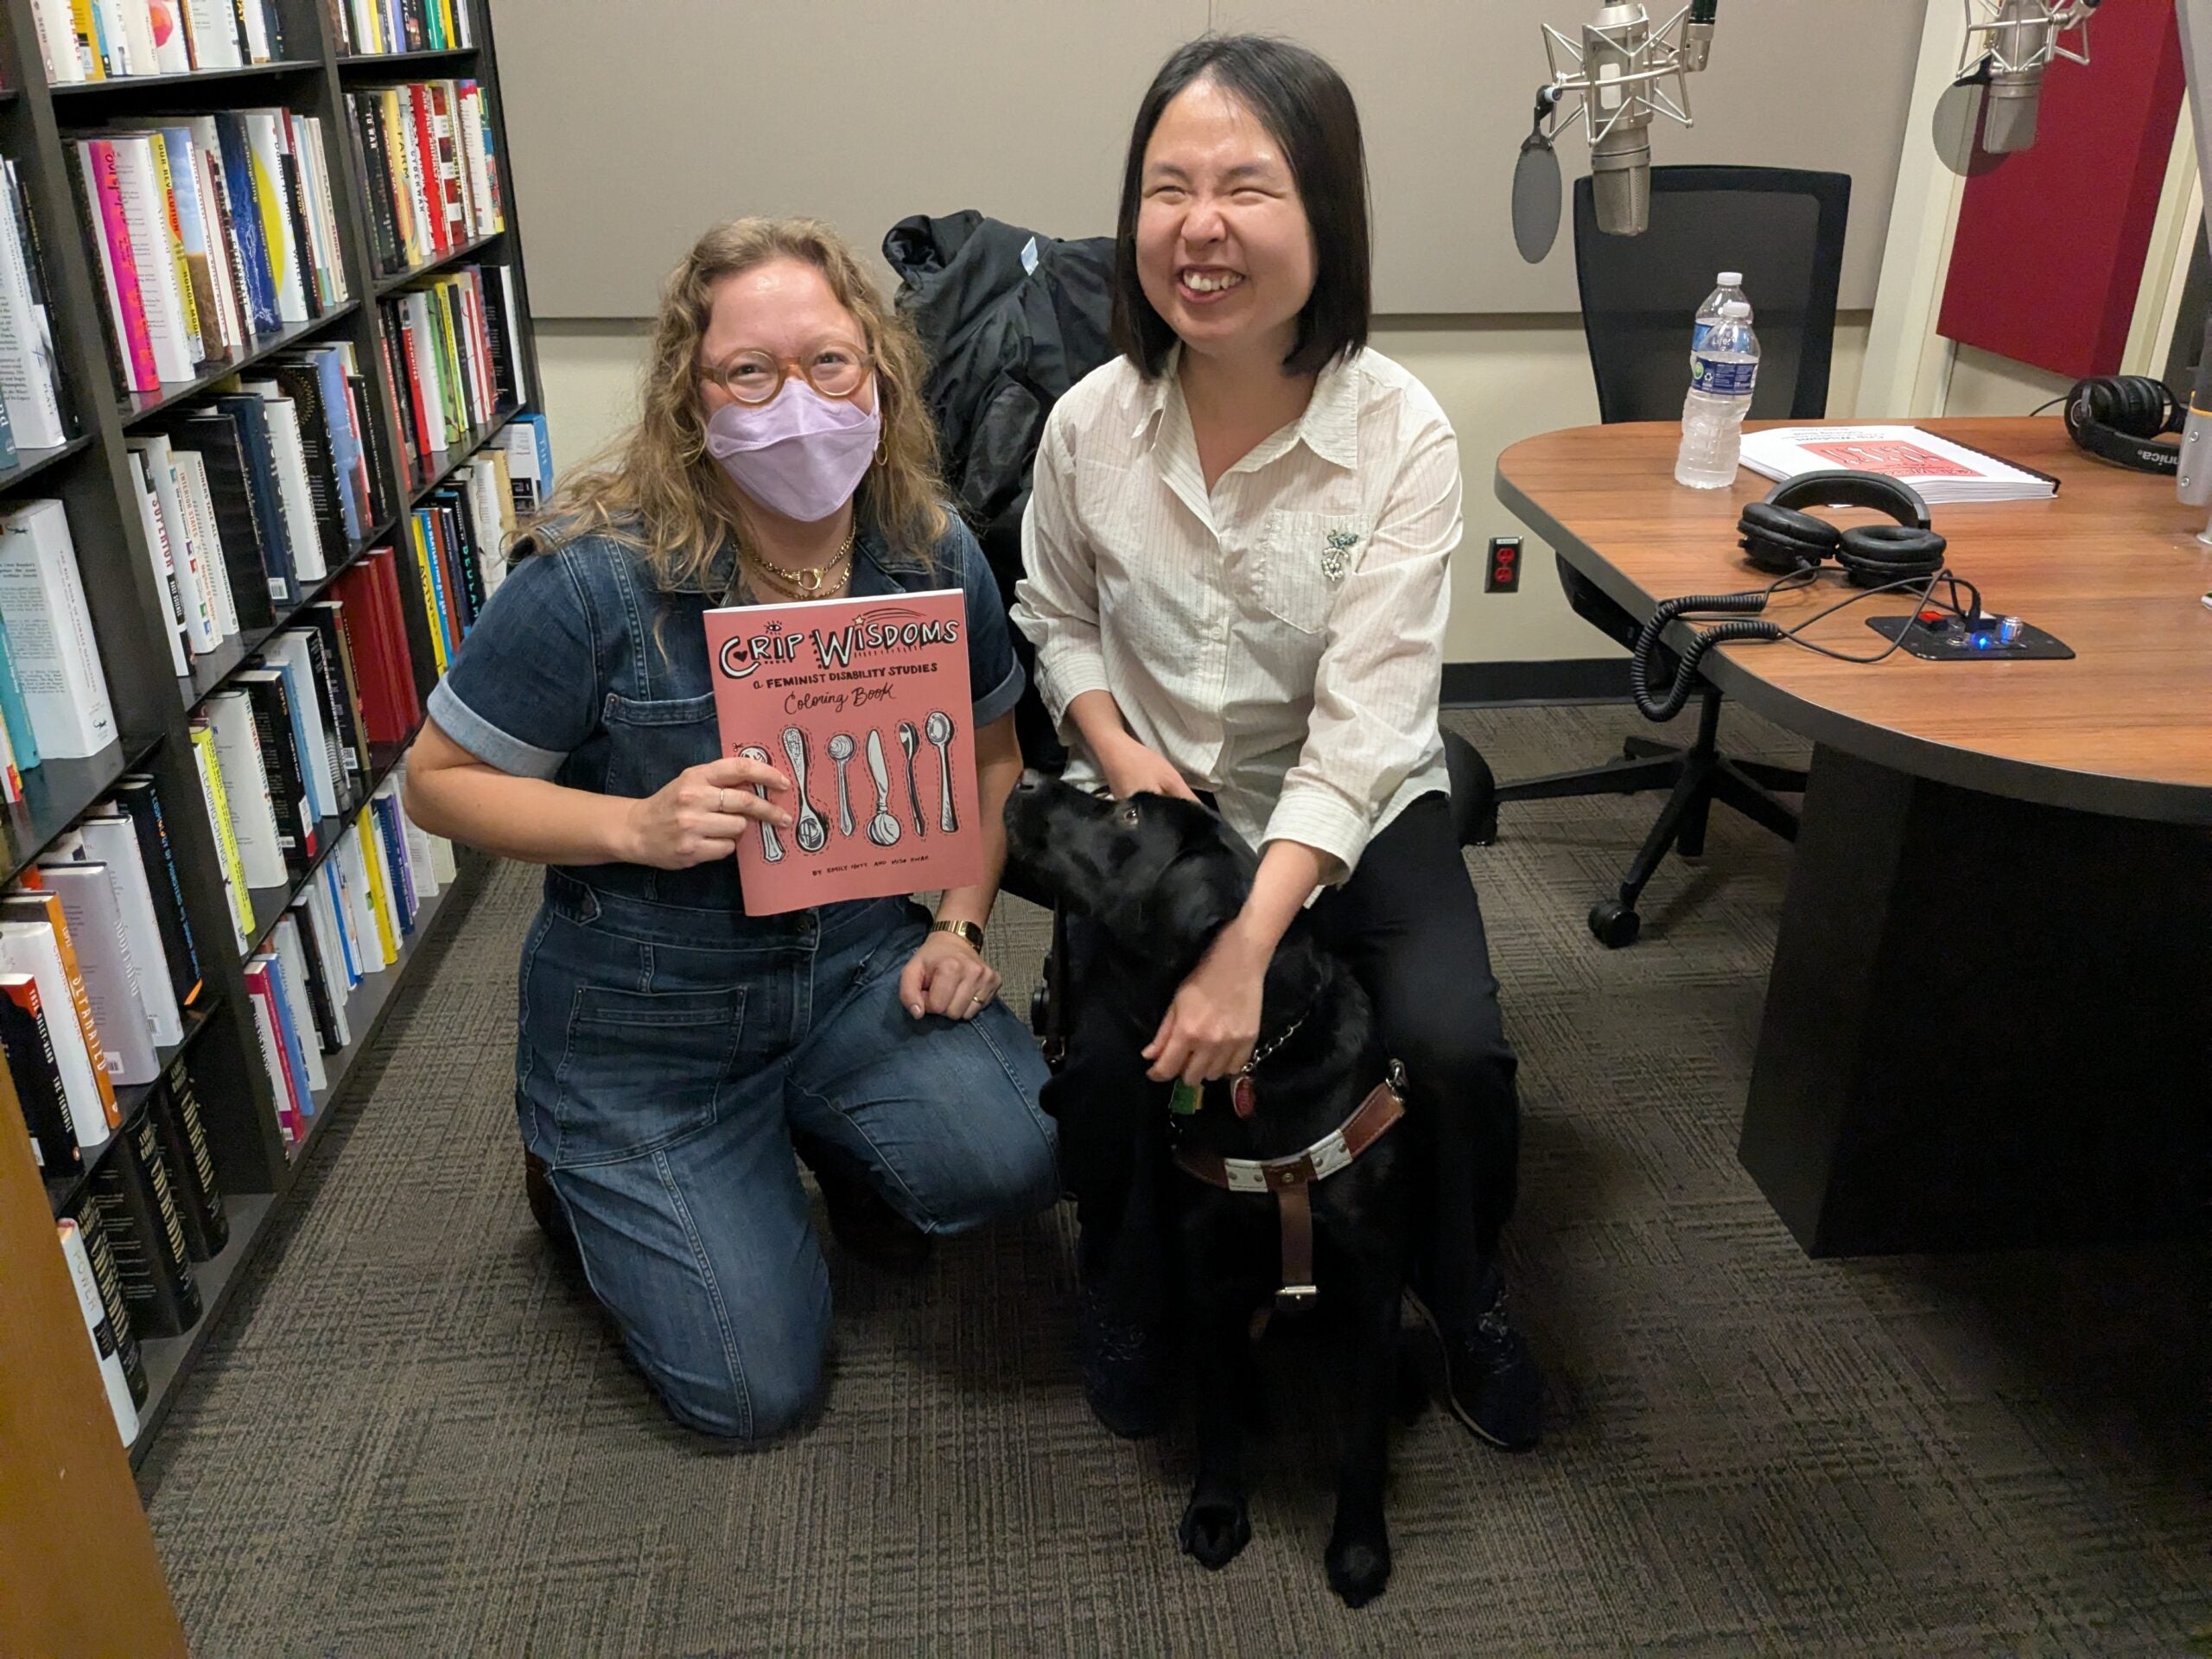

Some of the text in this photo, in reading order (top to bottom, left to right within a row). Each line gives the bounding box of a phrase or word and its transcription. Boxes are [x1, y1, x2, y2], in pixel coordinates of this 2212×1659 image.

[396, 130, 410, 179] FARM
[157, 143, 200, 343] OUR REVOLUTION HONOR MOORE
[405, 331, 419, 380] TYPEWRITER
[179, 471, 192, 509] INTERIOR
[188, 510, 198, 537] STATES
[196, 459, 209, 499] WINNERS
[150, 498, 175, 568] SUPERIOR
[460, 543, 481, 619] BEDLAM
[719, 620, 960, 679] CRIP WISDOMS
[766, 673, 826, 689] FEMINIST
[829, 667, 886, 683] DISABILITY
[888, 663, 938, 676] STUDIES
[276, 686, 289, 715] OPUS
[784, 691, 849, 715] Coloring
[247, 715, 260, 751] PRIMARY
[256, 753, 269, 790] SOLUTION
[200, 770, 219, 820] LEADING
[211, 820, 230, 869] CHANGE
[51, 1075, 63, 1093] THE
[56, 1093, 73, 1134] TERRIBLE
[73, 1251, 96, 1312] POWER
